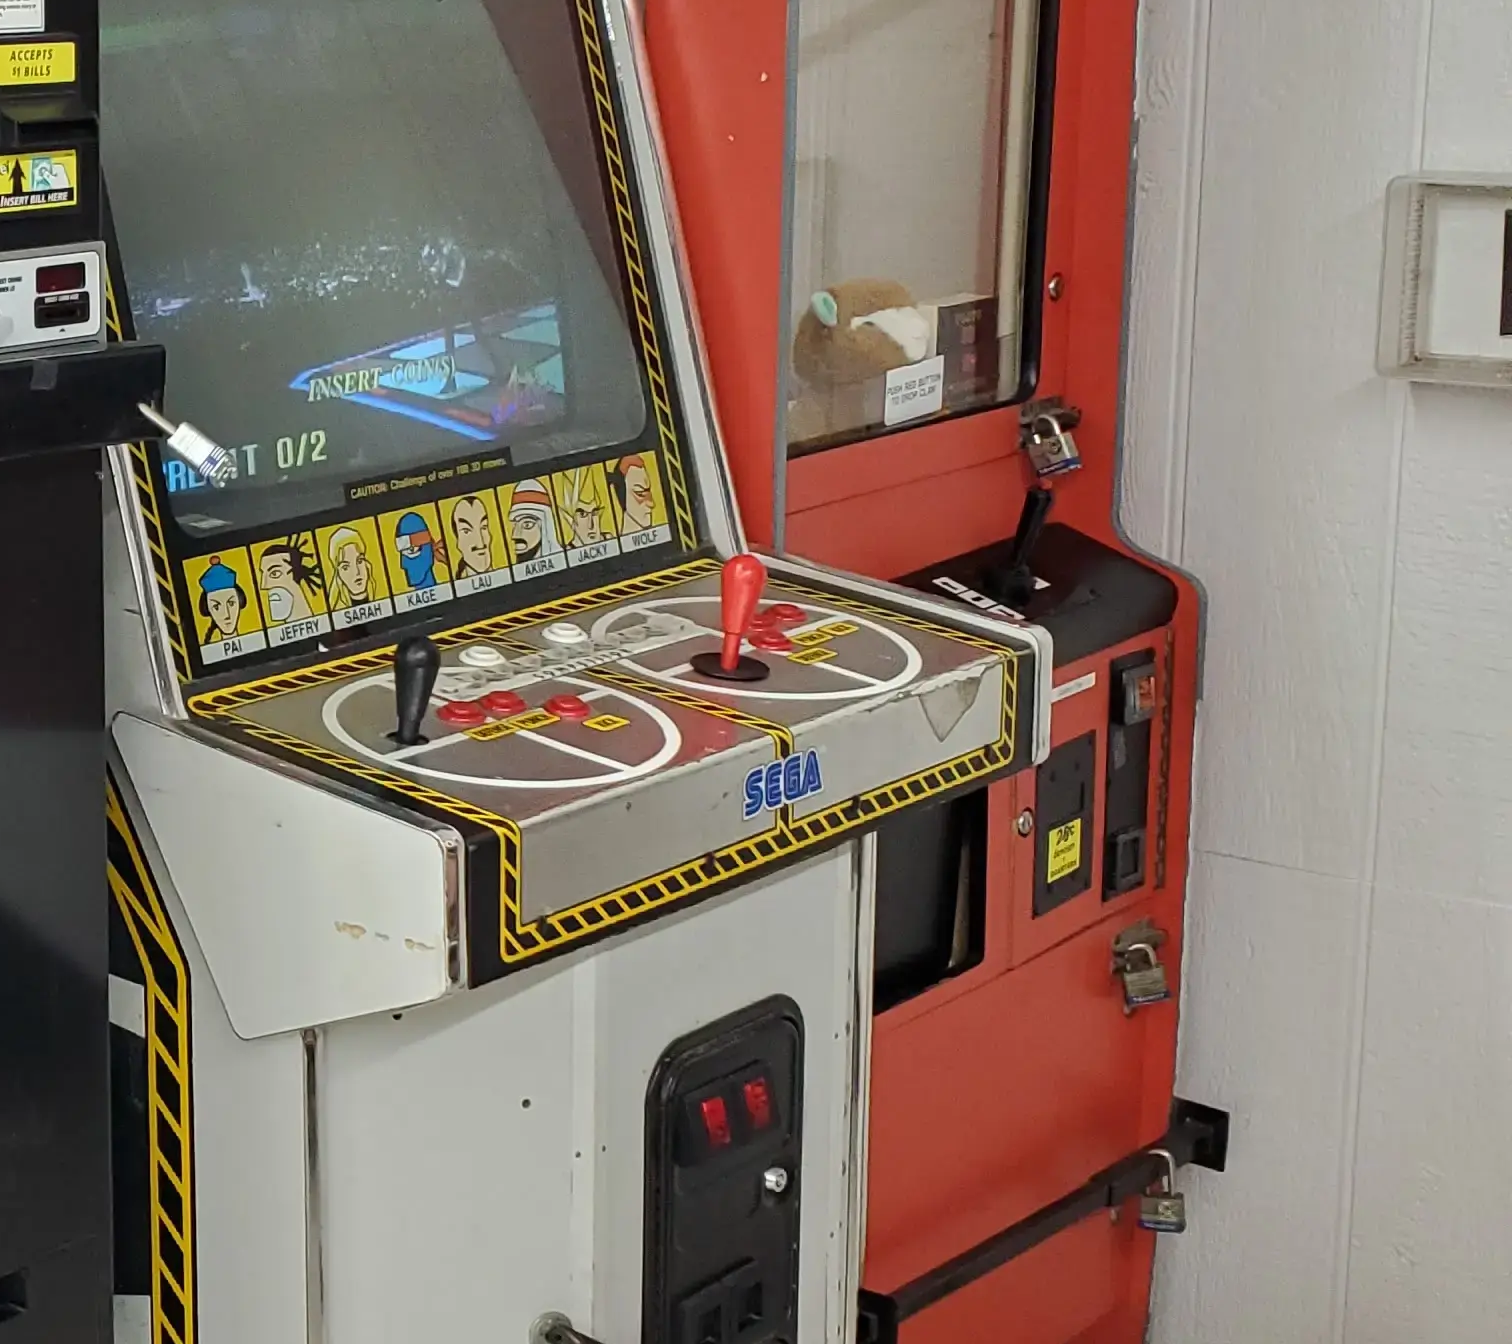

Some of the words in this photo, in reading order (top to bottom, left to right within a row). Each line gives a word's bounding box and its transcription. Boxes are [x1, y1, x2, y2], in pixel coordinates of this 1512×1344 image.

[9, 49, 54, 62] ACCEPTS
[12, 66, 21, 78] $1
[24, 65, 51, 77] BILLS
[0, 195, 29, 208] INSERT
[29, 193, 46, 205] BILL
[47, 190, 69, 202] HERE
[307, 366, 383, 403] INSERT
[276, 429, 328, 469] 0/2
[630, 531, 659, 548] WOLF
[577, 543, 609, 564] JACKY
[524, 558, 556, 577] AKIRA
[471, 575, 493, 592] LAU
[406, 588, 438, 608] KAGE
[344, 602, 383, 625] SARAH
[278, 620, 321, 641] JEFFRY
[222, 641, 243, 656] PAI
[741, 747, 823, 822] SEGA
